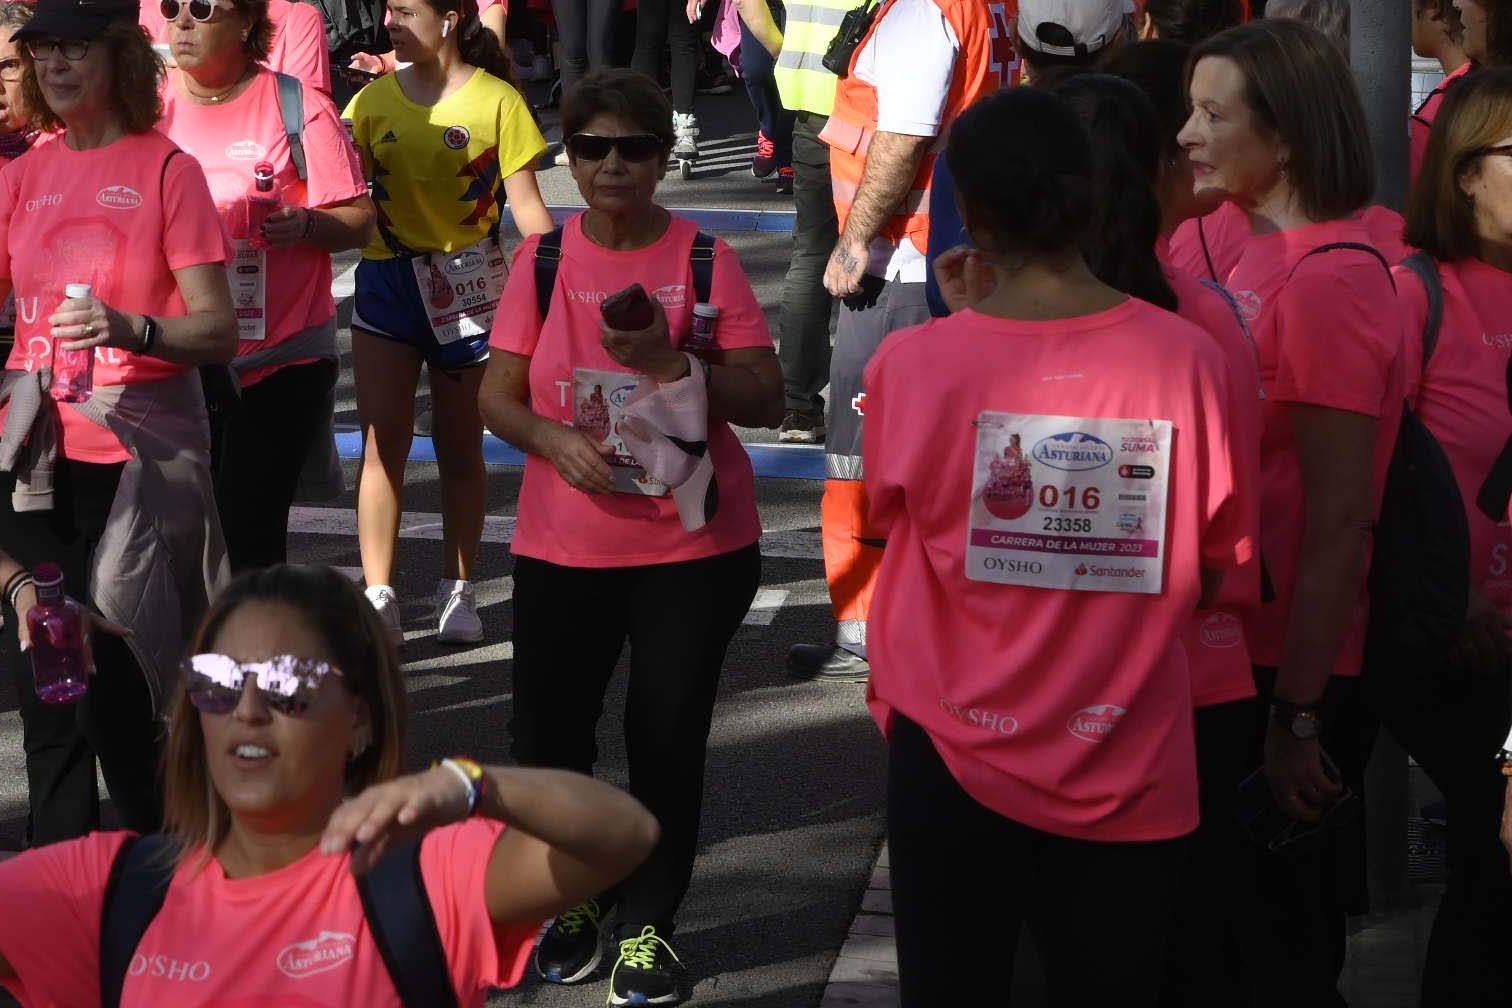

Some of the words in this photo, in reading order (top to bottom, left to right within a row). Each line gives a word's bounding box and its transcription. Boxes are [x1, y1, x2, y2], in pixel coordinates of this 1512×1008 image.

[455, 276, 488, 296] 016
[462, 293, 487, 308] 30554
[554, 380, 572, 408] T
[1039, 444, 1107, 463] ASTURIANA
[1119, 442, 1156, 453] SUMA
[1039, 484, 1101, 511] 016
[1043, 516, 1093, 533] 23358
[990, 535, 1044, 548] CARRERA
[1045, 541, 1062, 549] DE
[1063, 541, 1078, 550] LA
[1079, 542, 1116, 552] MUJER
[1118, 544, 1144, 553] 2023
[983, 557, 1043, 574] OYSHO
[1089, 566, 1147, 578] Santander
